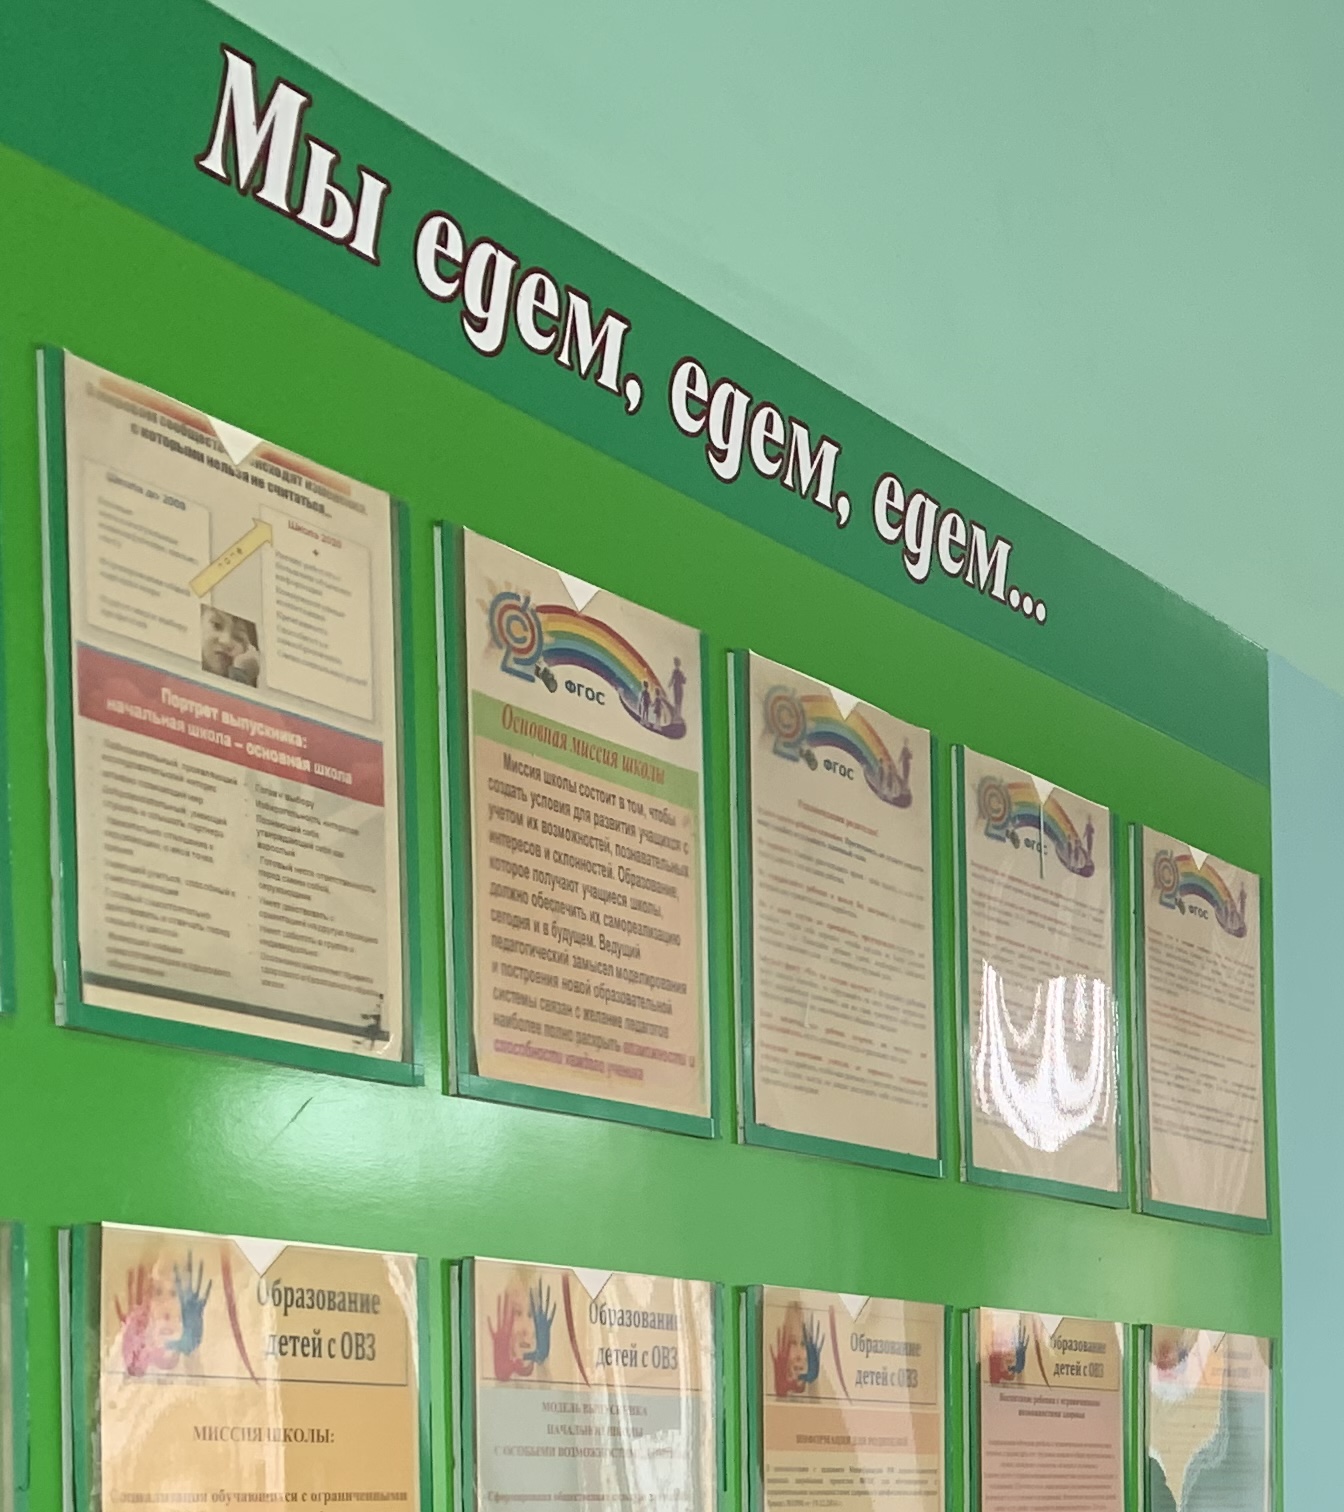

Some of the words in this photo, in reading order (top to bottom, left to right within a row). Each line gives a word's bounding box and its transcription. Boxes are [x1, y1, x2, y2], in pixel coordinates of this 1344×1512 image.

[196, 44, 391, 266] Мы
[413, 209, 647, 414] едем,
[668, 355, 853, 529] едем,
[872, 473, 1049, 625] едем...
[565, 680, 605, 706] ФГОС
[161, 687, 219, 722] Портрет
[221, 712, 307, 748] выпускника:
[106, 699, 186, 733] начальная
[187, 724, 232, 748] школа
[246, 742, 311, 773] основная
[314, 761, 353, 785] школа
[502, 703, 567, 751] Основная
[570, 736, 619, 769] миссия
[622, 754, 665, 785] школы
[823, 758, 855, 780] ФГОС
[503, 752, 541, 782] Миссия
[543, 770, 577, 794] школы
[579, 783, 616, 806] состоит
[618, 796, 625, 810] в
[627, 798, 647, 819] том,
[649, 806, 677, 827] чтобы
[487, 777, 528, 803] создать
[530, 791, 571, 817] условия
[573, 806, 591, 823] для
[593, 811, 637, 837] развития
[488, 803, 523, 827] учетом
[526, 816, 538, 831] их
[541, 819, 613, 857] возможностей,
[488, 830, 542, 857] интересов
[544, 846, 550, 861] и
[552, 849, 615, 880] склонностей.
[489, 856, 530, 879] которое
[532, 868, 579, 892] получают
[581, 883, 628, 908] учащиеся
[531, 891, 587, 920] обеспечить
[589, 910, 600, 924] их
[1188, 904, 1209, 920] ФГОС
[533, 920, 540, 933] и
[543, 922, 549, 935] в
[551, 921, 597, 949] будущем.
[599, 933, 641, 959] Ведущий
[572, 955, 614, 977] замысел
[562, 979, 591, 996] новой
[256, 1278, 381, 1316] Образование
[589, 1301, 679, 1332] Образовани
[265, 1329, 322, 1361] детей
[328, 1341, 336, 1358] с
[340, 1332, 377, 1361] ОВЗ
[596, 1345, 638, 1369] детей
[641, 1353, 648, 1368] с
[651, 1347, 679, 1370] ОВЗ
[850, 1332, 921, 1358] Образование
[855, 1366, 888, 1388] детей
[890, 1373, 895, 1386] с
[897, 1368, 918, 1389] ОВЗ
[1053, 1361, 1081, 1378] детей
[1083, 1365, 1087, 1376] с
[193, 1426, 262, 1443] МИССИЯ
[266, 1427, 335, 1444] ШКОЛЫ:
[301, 1493, 307, 1503] с
